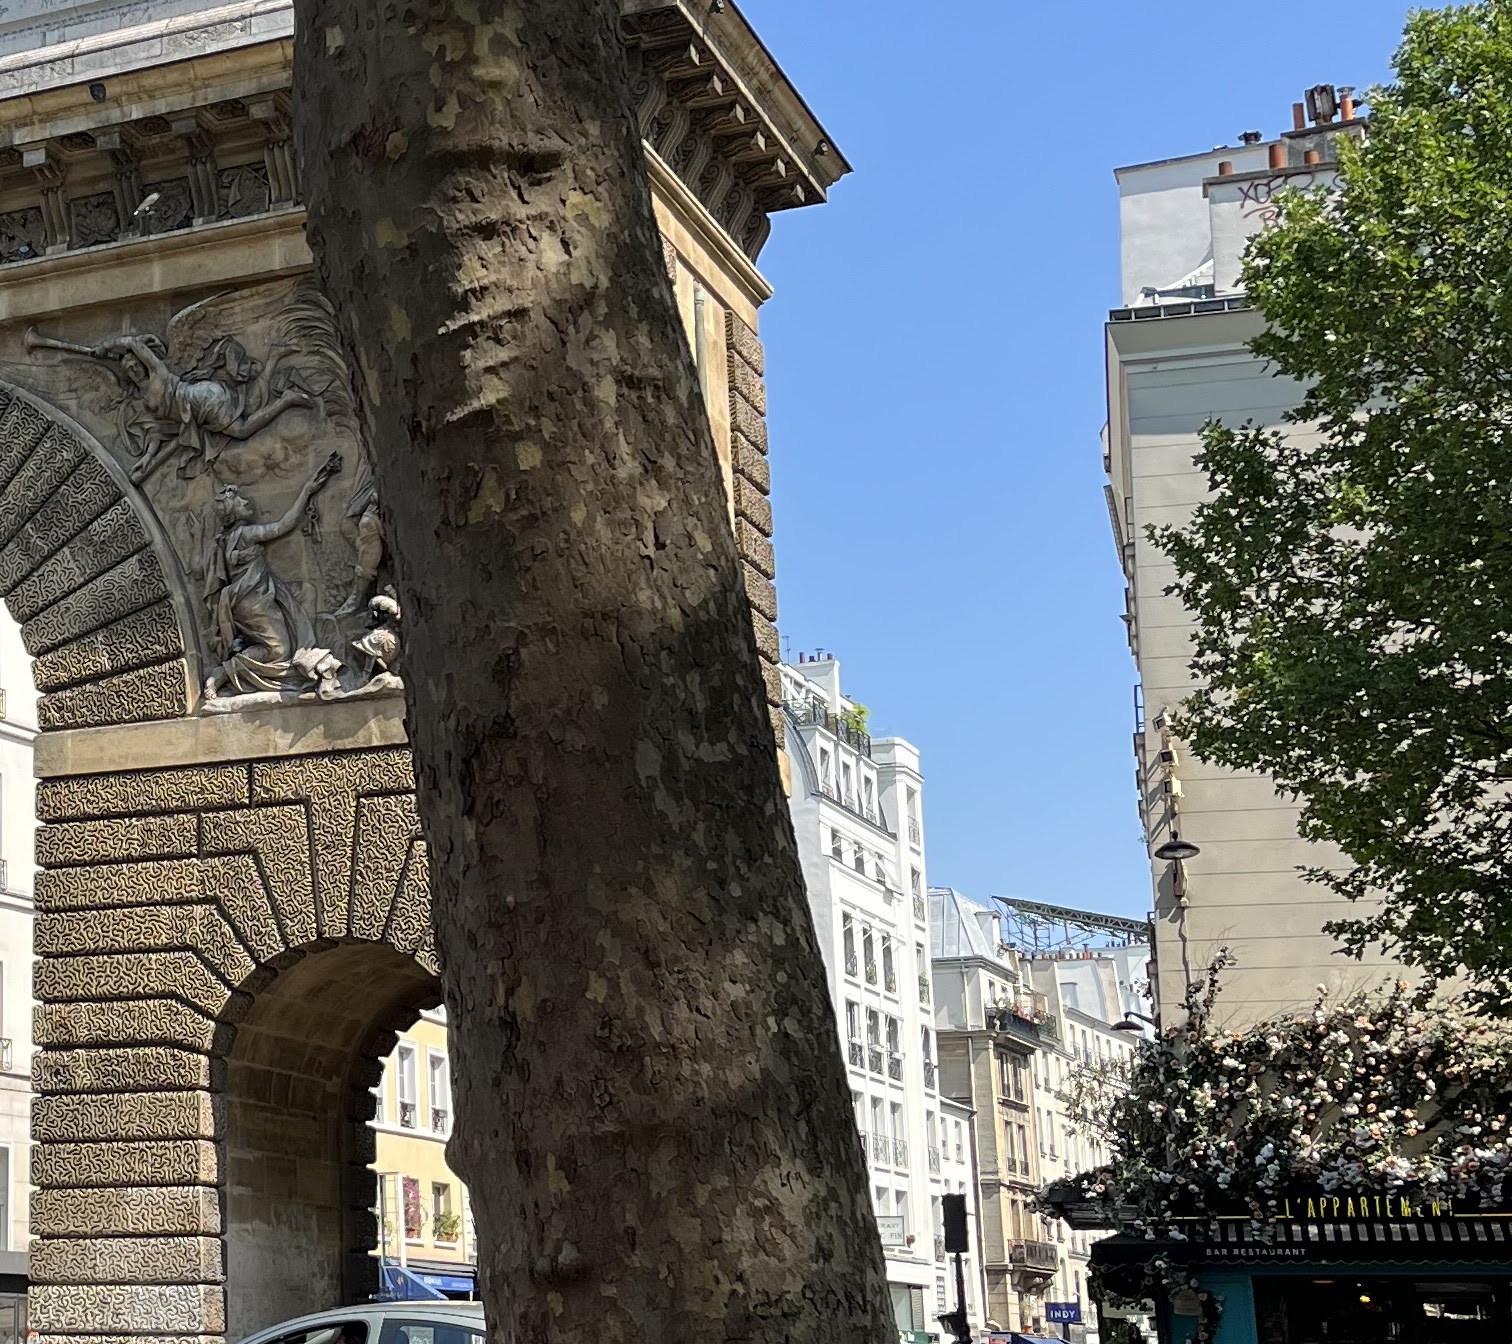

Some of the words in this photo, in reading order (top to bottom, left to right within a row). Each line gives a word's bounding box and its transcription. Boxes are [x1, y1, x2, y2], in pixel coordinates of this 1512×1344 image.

[1206, 1248, 1228, 1256] BAR
[1233, 1248, 1307, 1256] RESTAURANT
[1049, 1310, 1076, 1320] INDY
